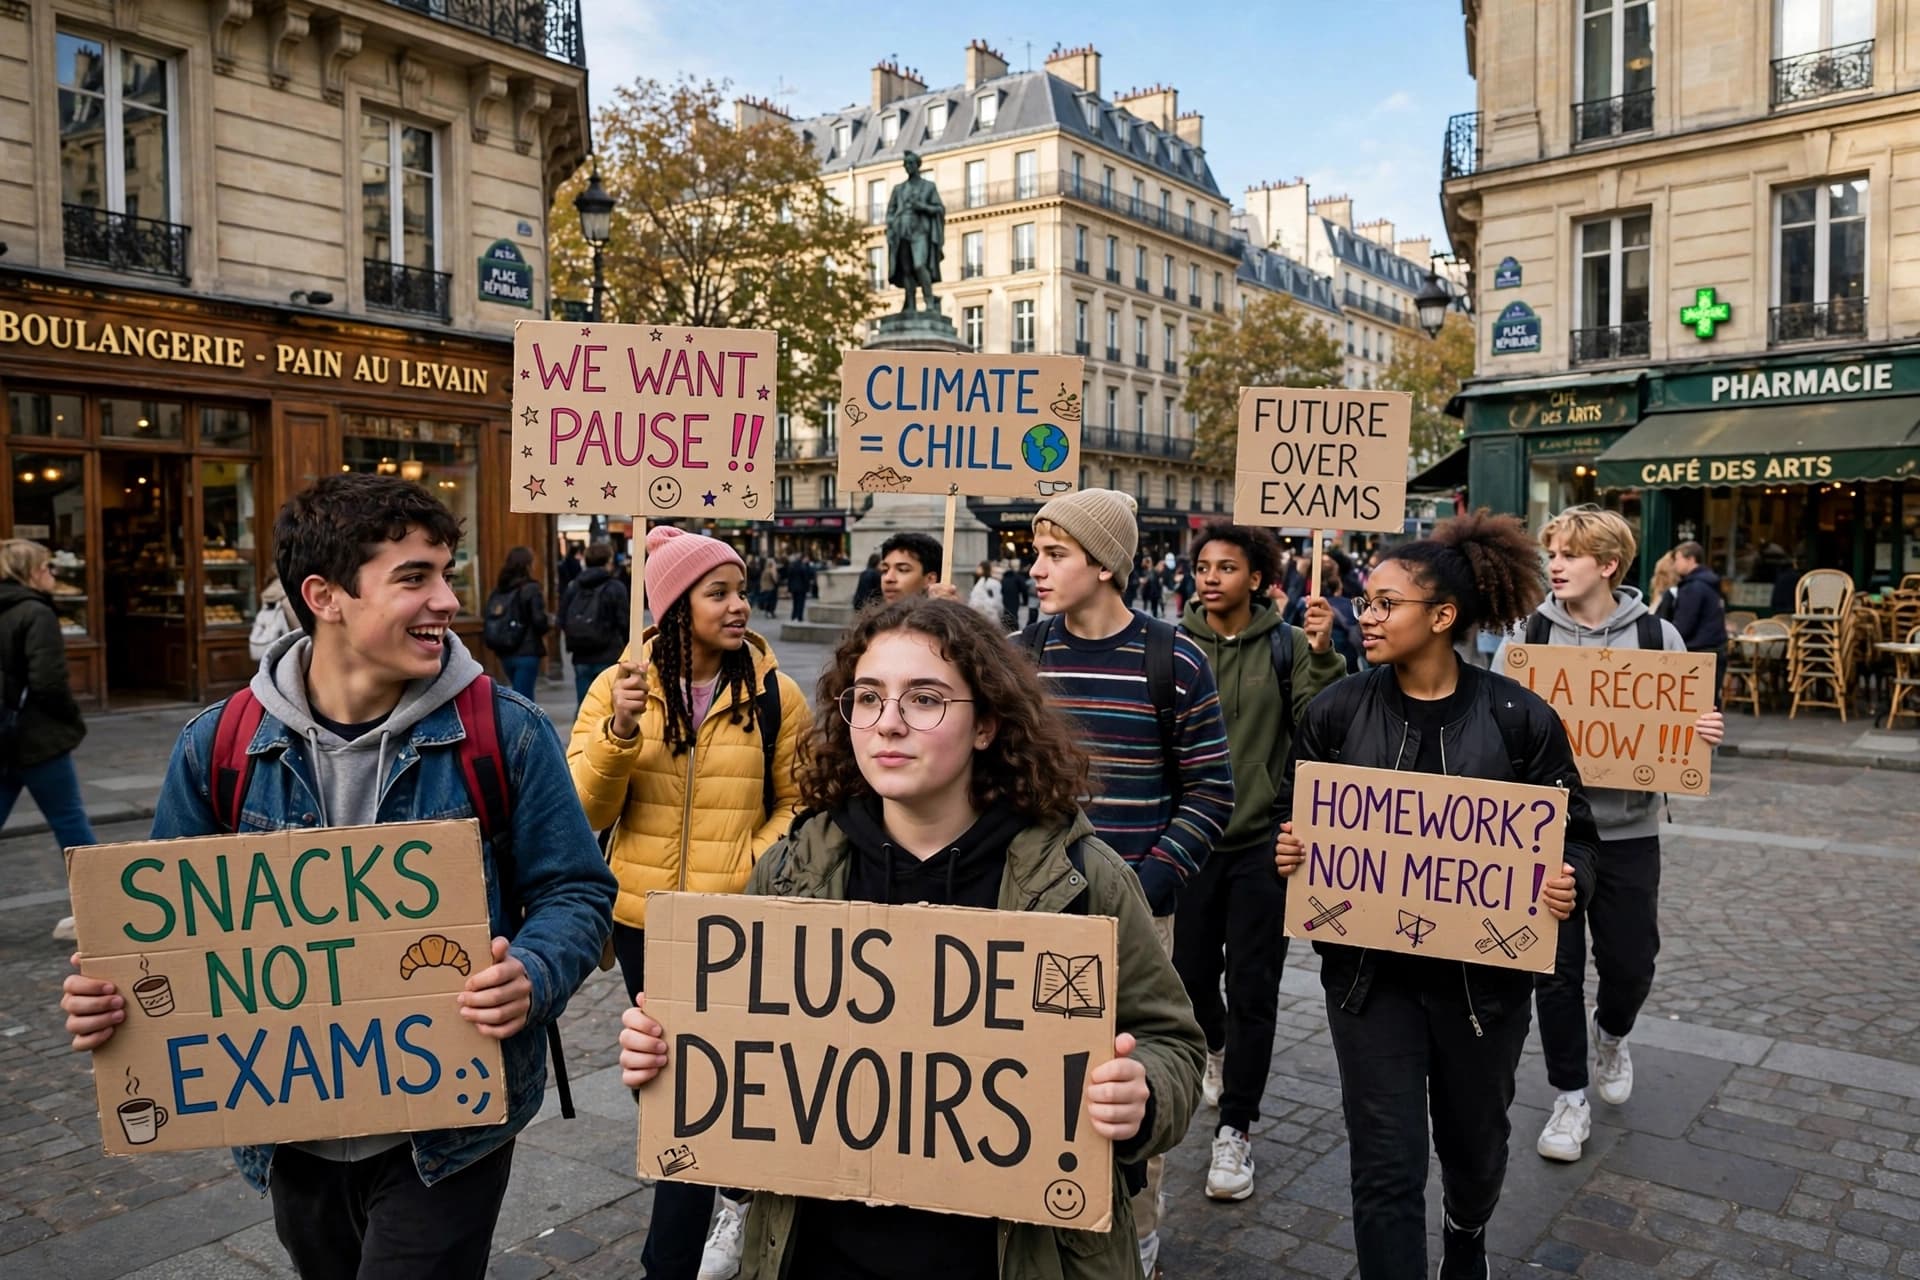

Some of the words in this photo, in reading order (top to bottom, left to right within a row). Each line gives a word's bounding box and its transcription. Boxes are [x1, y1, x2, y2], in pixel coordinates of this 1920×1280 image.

[0, 310, 245, 368] BOULANGERIE
[276, 344, 343, 378] PAIN
[353, 354, 390, 384] AU
[400, 359, 489, 394] LEVAIN
[533, 343, 608, 393] WE
[627, 347, 758, 398] WANT
[866, 365, 1040, 414] CLIMATE
[1711, 363, 1893, 401] PHARMACIE
[550, 407, 709, 469] PAUSE
[1255, 398, 1389, 437] FUTURE
[898, 423, 1013, 470] CHILL
[1271, 441, 1358, 478] OVER
[1641, 458, 1701, 484] CAFÉ
[1710, 459, 1756, 481] DES
[1764, 456, 1832, 479] ARTS
[1260, 481, 1381, 520] EXAMS
[1590, 663, 1699, 712] RÉCRÉ
[1561, 718, 1645, 761] NOW
[1311, 779, 1556, 854] HOMEWORK?
[120, 839, 440, 943] SNACKS
[1309, 842, 1387, 894] NON
[1401, 853, 1514, 911] MERCI
[205, 937, 356, 1018] NOT
[696, 914, 896, 1024] PLUS
[932, 934, 1025, 1031] DE
[167, 1014, 442, 1116] EXAMS
[674, 1033, 1032, 1168] DEVOIRS
